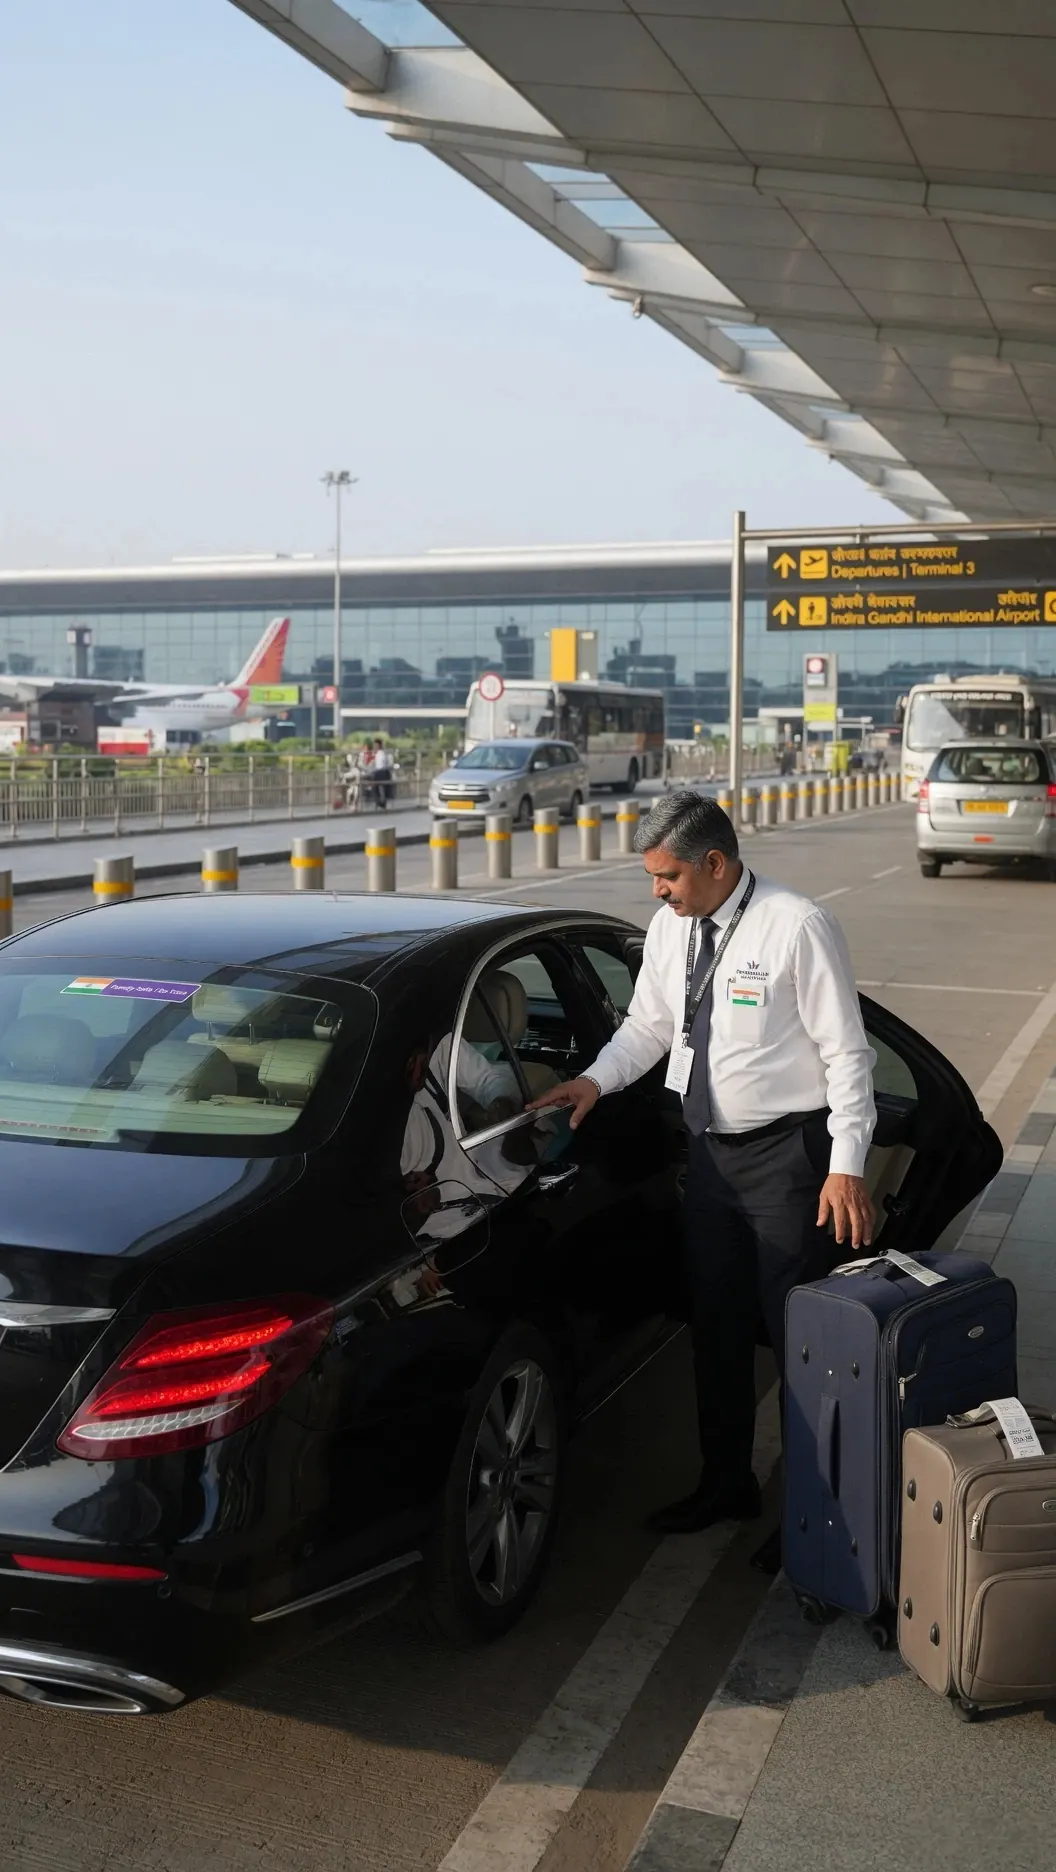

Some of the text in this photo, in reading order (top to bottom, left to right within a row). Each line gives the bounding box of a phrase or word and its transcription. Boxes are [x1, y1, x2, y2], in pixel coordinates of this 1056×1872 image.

[832, 565, 899, 580] Departures
[910, 562, 963, 576] Terminal
[966, 561, 975, 575] 3
[831, 608, 1040, 625] Indira Gandhi International Airport
